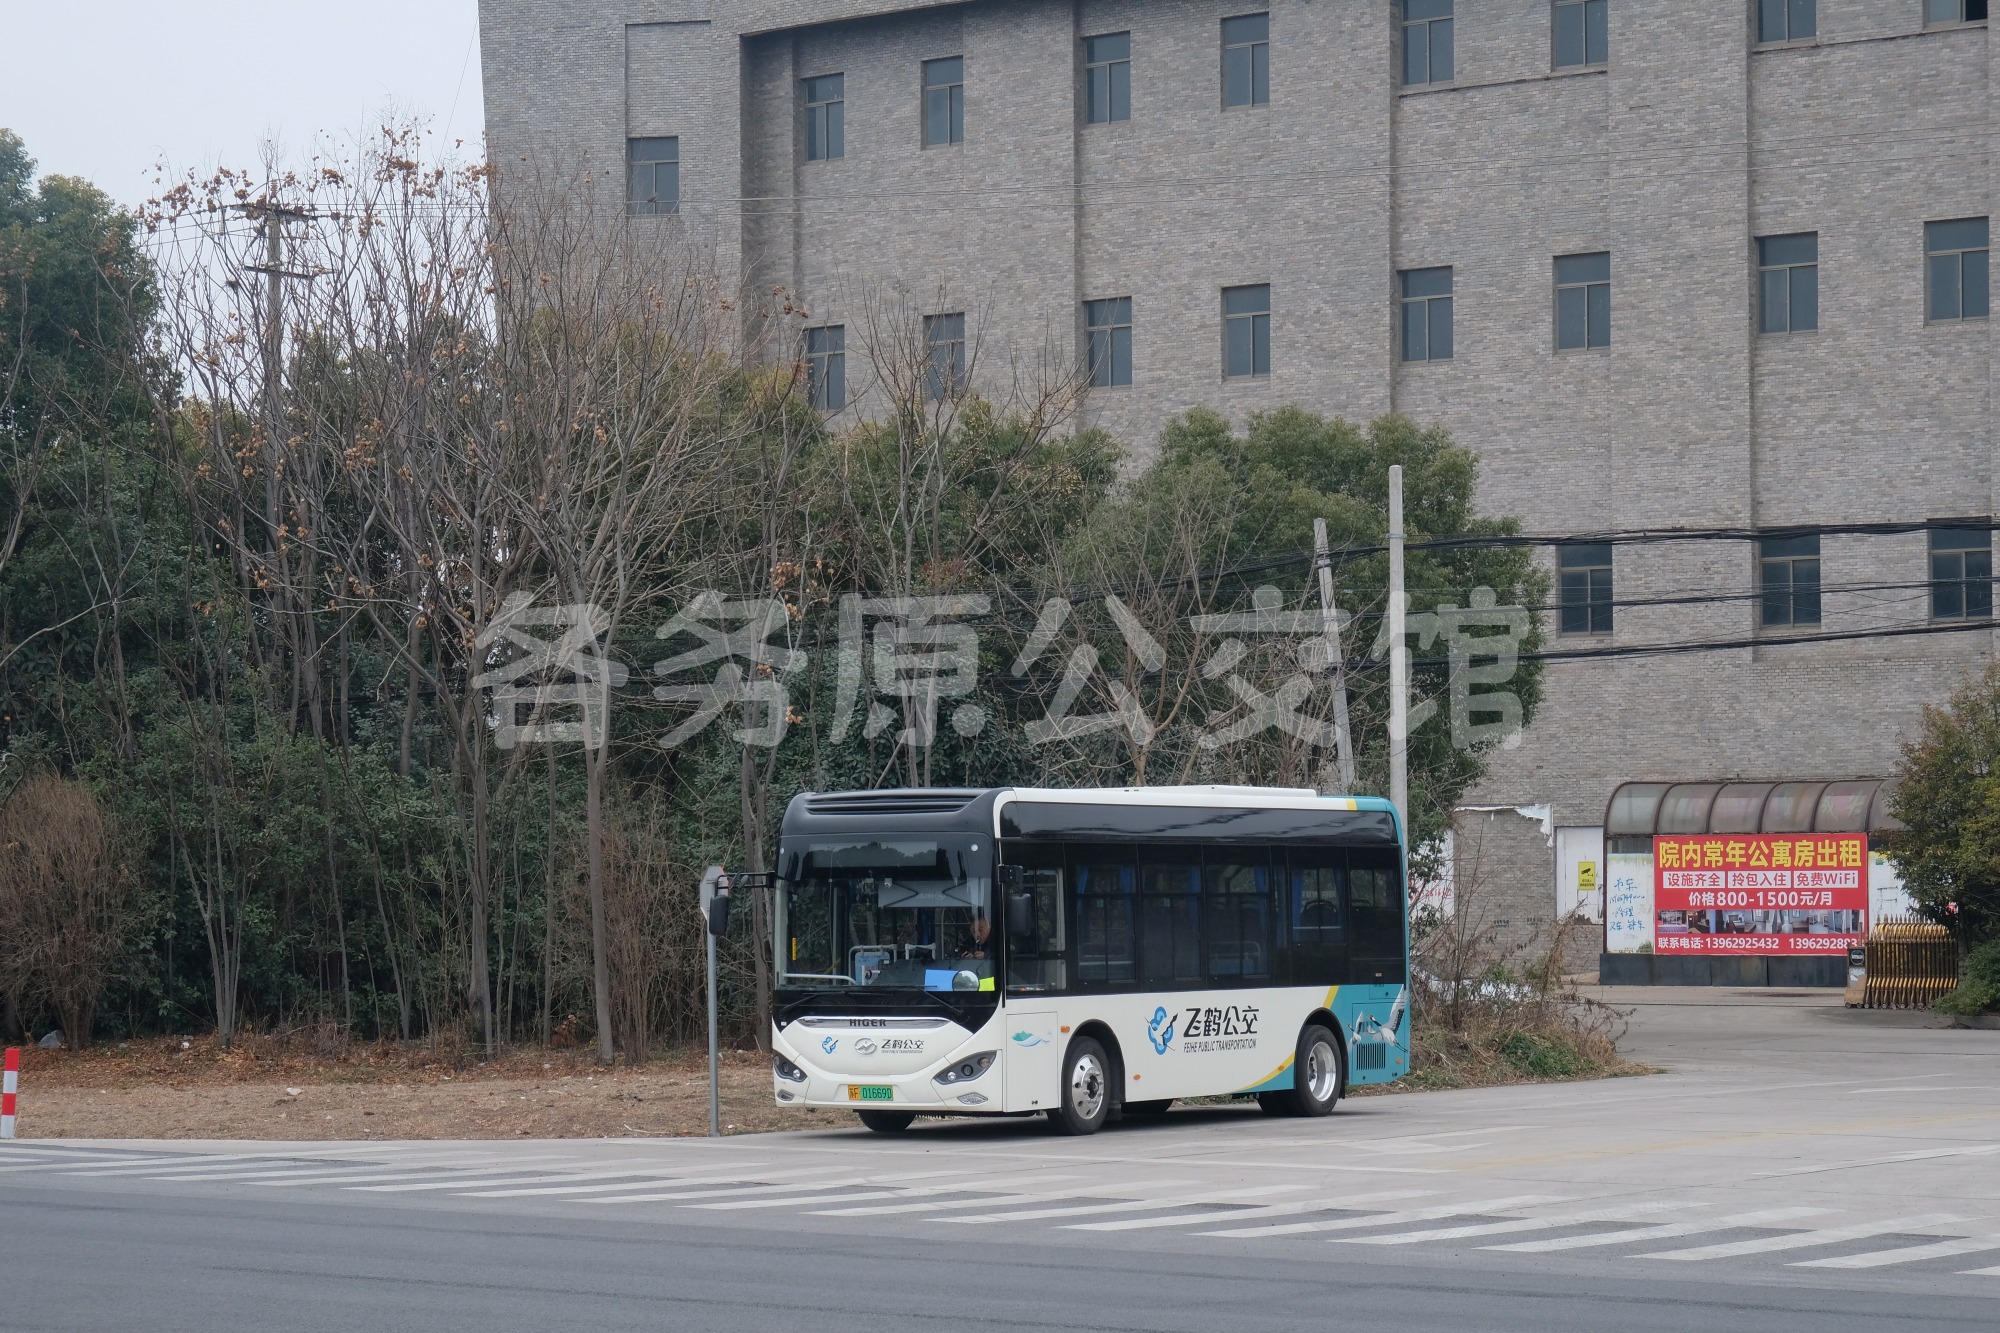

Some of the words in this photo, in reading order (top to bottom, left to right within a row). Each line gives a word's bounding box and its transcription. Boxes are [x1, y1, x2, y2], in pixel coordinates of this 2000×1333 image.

[1659, 840, 1862, 868] 院内常年公寓房出租
[1668, 873, 1721, 887] 设施齐全
[1732, 873, 1787, 887] 拎包入住
[1797, 872, 1857, 887] 免费WiFi
[1688, 891, 1833, 907] 价格800-1500元/月
[1658, 937, 1704, 949] 联系电话:
[1706, 937, 1780, 949] 13962925432
[849, 1018, 887, 1027] HIGER
[1183, 1005, 1259, 1038] 飞鹤公交
[881, 1039, 925, 1050] 飞鹤公交
[1184, 1042, 1198, 1053] FEIHE
[1198, 1041, 1215, 1052] PUBLIC
[1215, 1038, 1257, 1051] TRANSPORTATION
